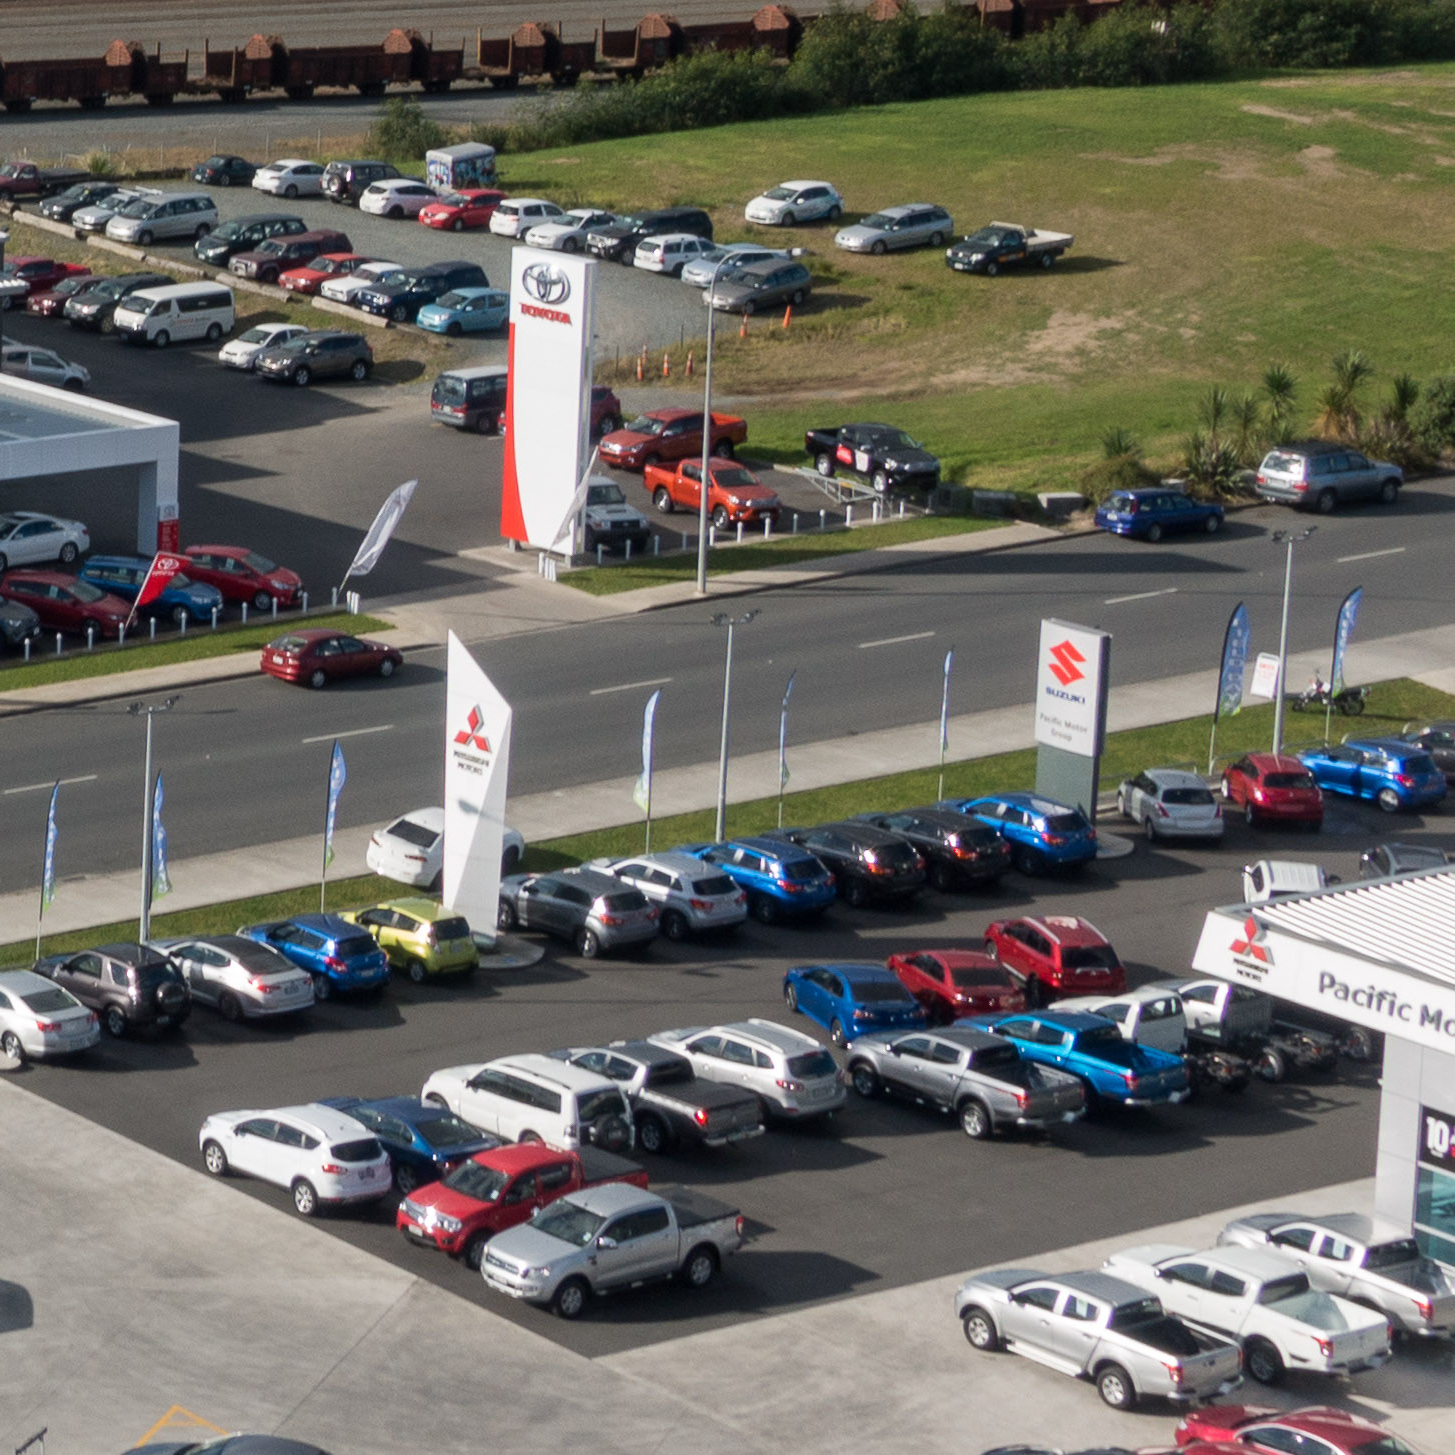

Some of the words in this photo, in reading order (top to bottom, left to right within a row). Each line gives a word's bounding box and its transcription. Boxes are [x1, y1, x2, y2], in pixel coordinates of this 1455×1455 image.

[520, 303, 572, 325] TOYOTA
[1045, 686, 1085, 704] SUZUKI
[1318, 971, 1413, 1023] Pacific
